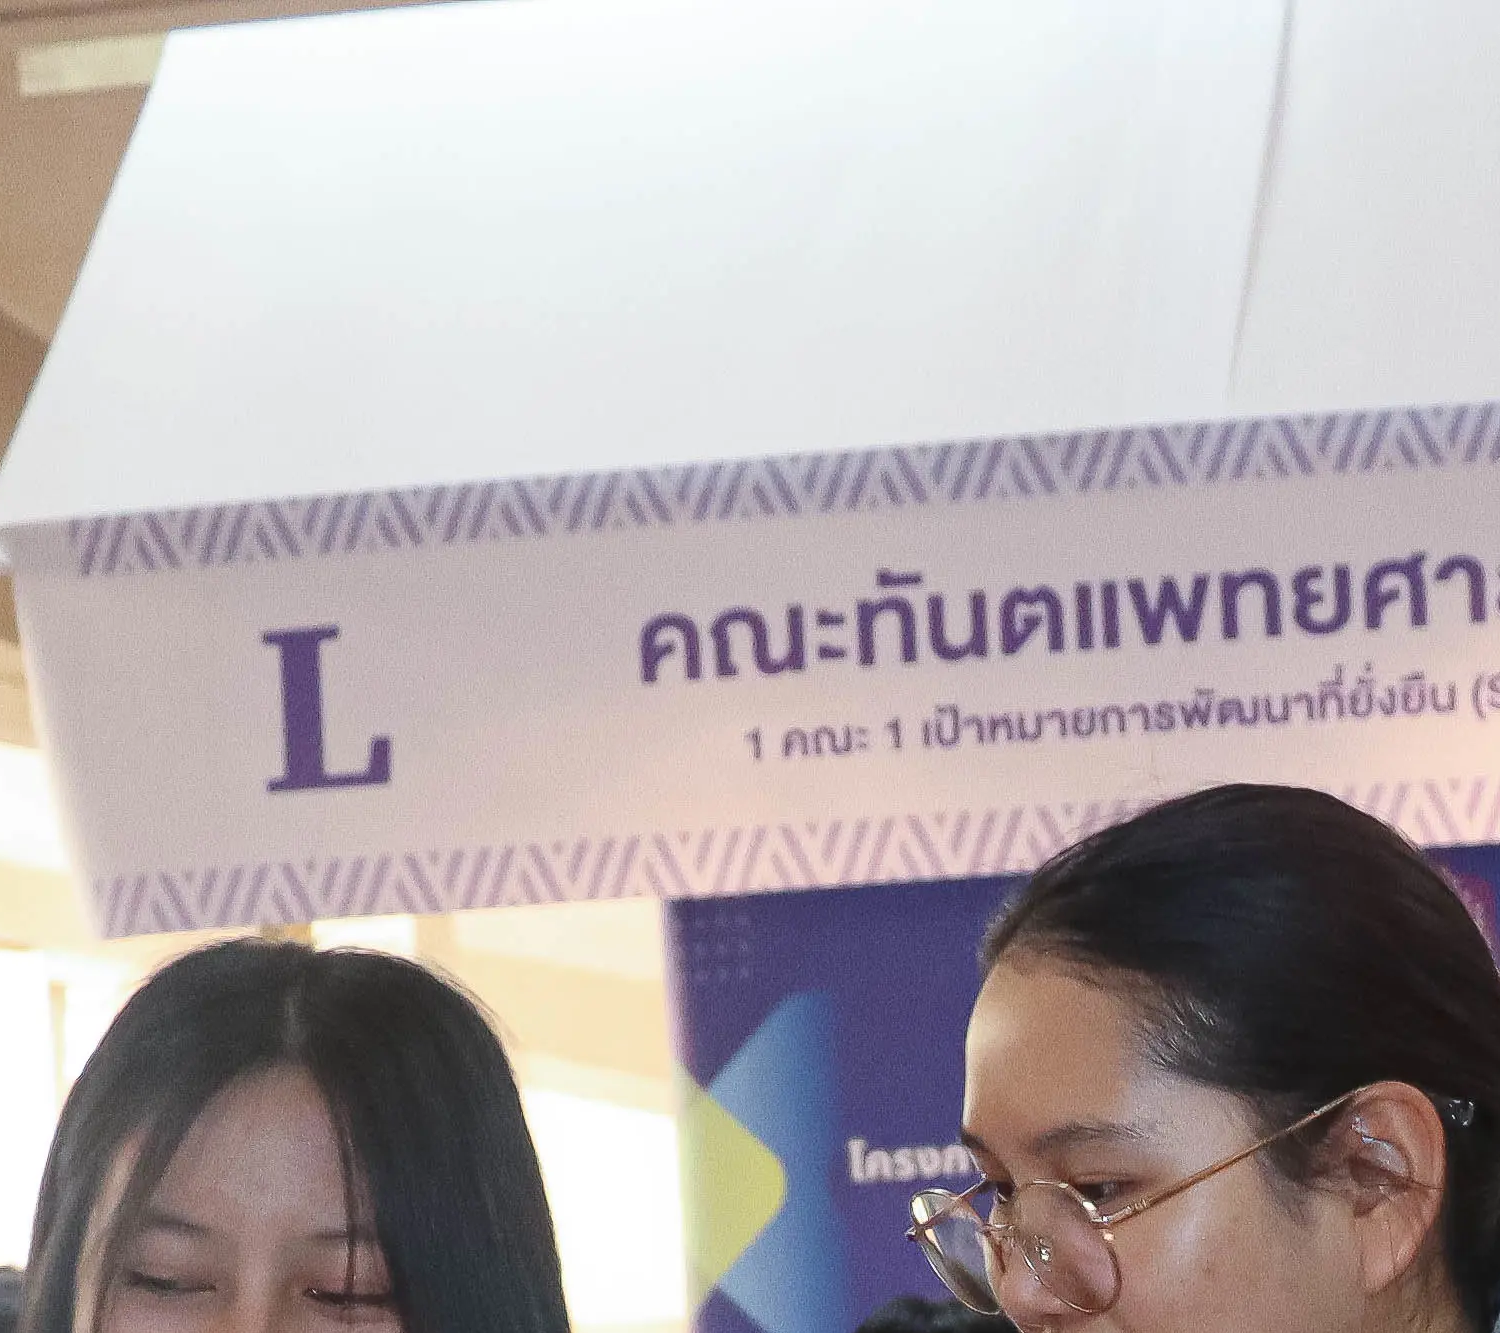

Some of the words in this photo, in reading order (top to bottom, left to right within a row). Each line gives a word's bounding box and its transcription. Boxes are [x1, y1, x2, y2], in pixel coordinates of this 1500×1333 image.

[262, 625, 392, 792] L
[745, 727, 763, 761] 1
[781, 722, 868, 758] คณะ
[886, 717, 904, 751] 1
[922, 664, 1458, 748] เป้าหมายการพัฒนาที่ยั่งยืน
